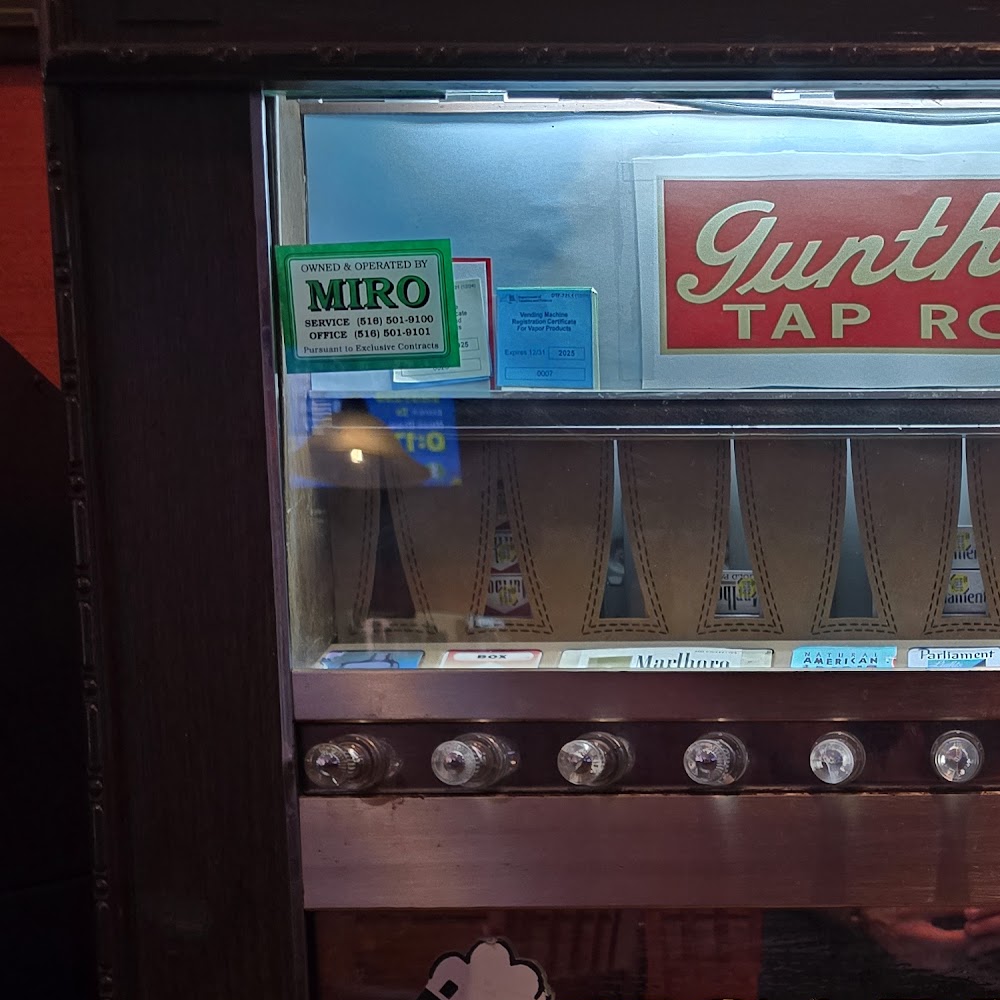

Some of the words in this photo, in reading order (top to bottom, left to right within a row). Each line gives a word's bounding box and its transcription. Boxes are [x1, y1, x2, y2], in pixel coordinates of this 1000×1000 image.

[301, 263, 341, 273] OWNED
[344, 263, 352, 271] &
[354, 260, 412, 271] OPERATED
[415, 259, 428, 269] BY
[305, 275, 430, 312] MIRO
[519, 311, 543, 319] Vending
[305, 318, 350, 328] SERVICE
[357, 316, 383, 327] (516)
[386, 315, 434, 325] 501-9100
[511, 318, 546, 326] Registration
[547, 318, 577, 326] Certificate
[722, 304, 871, 339] TAP
[309, 330, 348, 340] OFFICE
[354, 329, 380, 339] (516)
[383, 327, 431, 338] 501-9101
[528, 325, 545, 333] Vapor
[303, 345, 342, 354] Pursuant
[345, 344, 353, 353] to
[356, 343, 396, 352] Exclusive
[398, 342, 439, 351] Contracts
[504, 349, 527, 357] Expires
[920, 649, 995, 660] Parliament
[803, 656, 878, 666] AMERICAN
